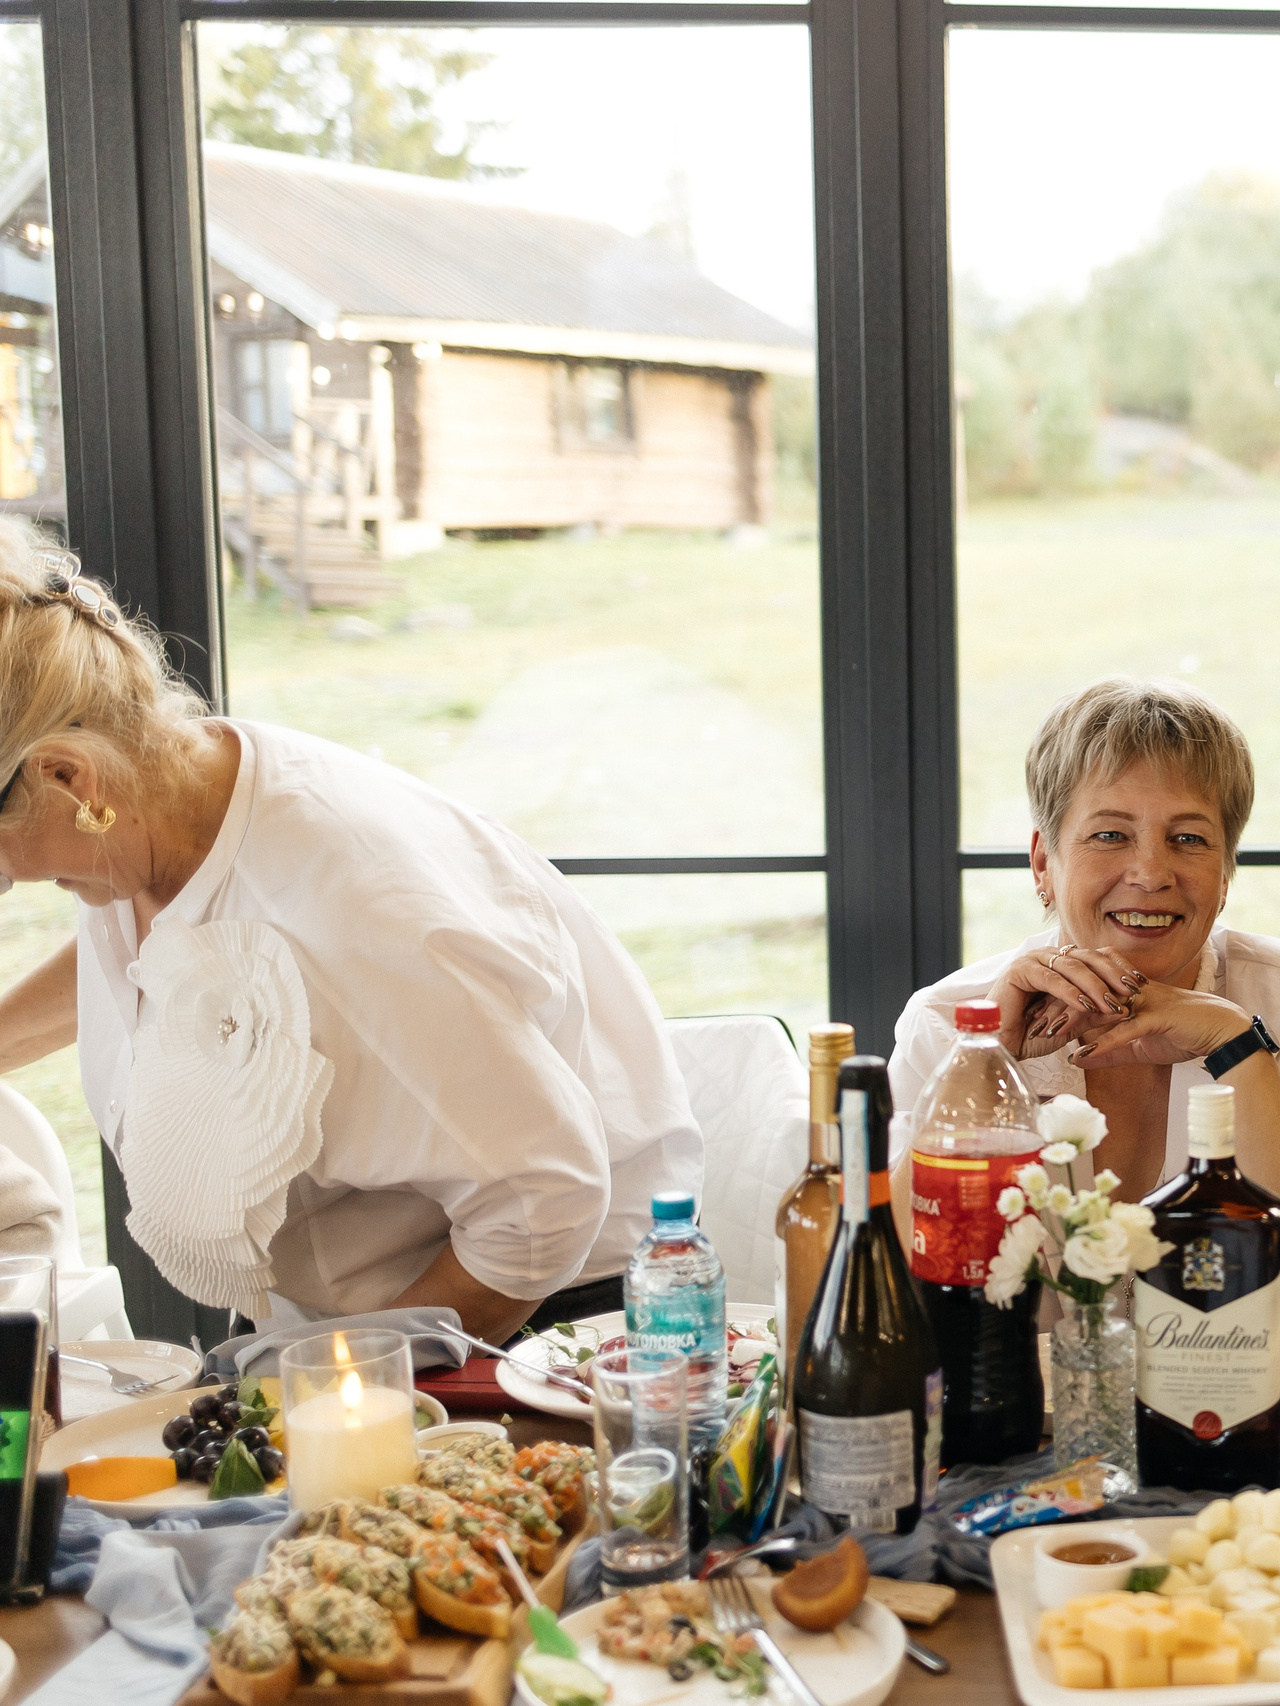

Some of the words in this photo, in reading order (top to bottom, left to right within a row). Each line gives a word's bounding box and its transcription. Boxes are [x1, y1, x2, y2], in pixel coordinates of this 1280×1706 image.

[1143, 1311, 1270, 1351] Ballantine's
[1181, 1352, 1231, 1362] FINEST
[1147, 1364, 1188, 1374] BLENDED
[1192, 1366, 1229, 1374] SCOTCH
[1232, 1367, 1268, 1375] WHISKY
